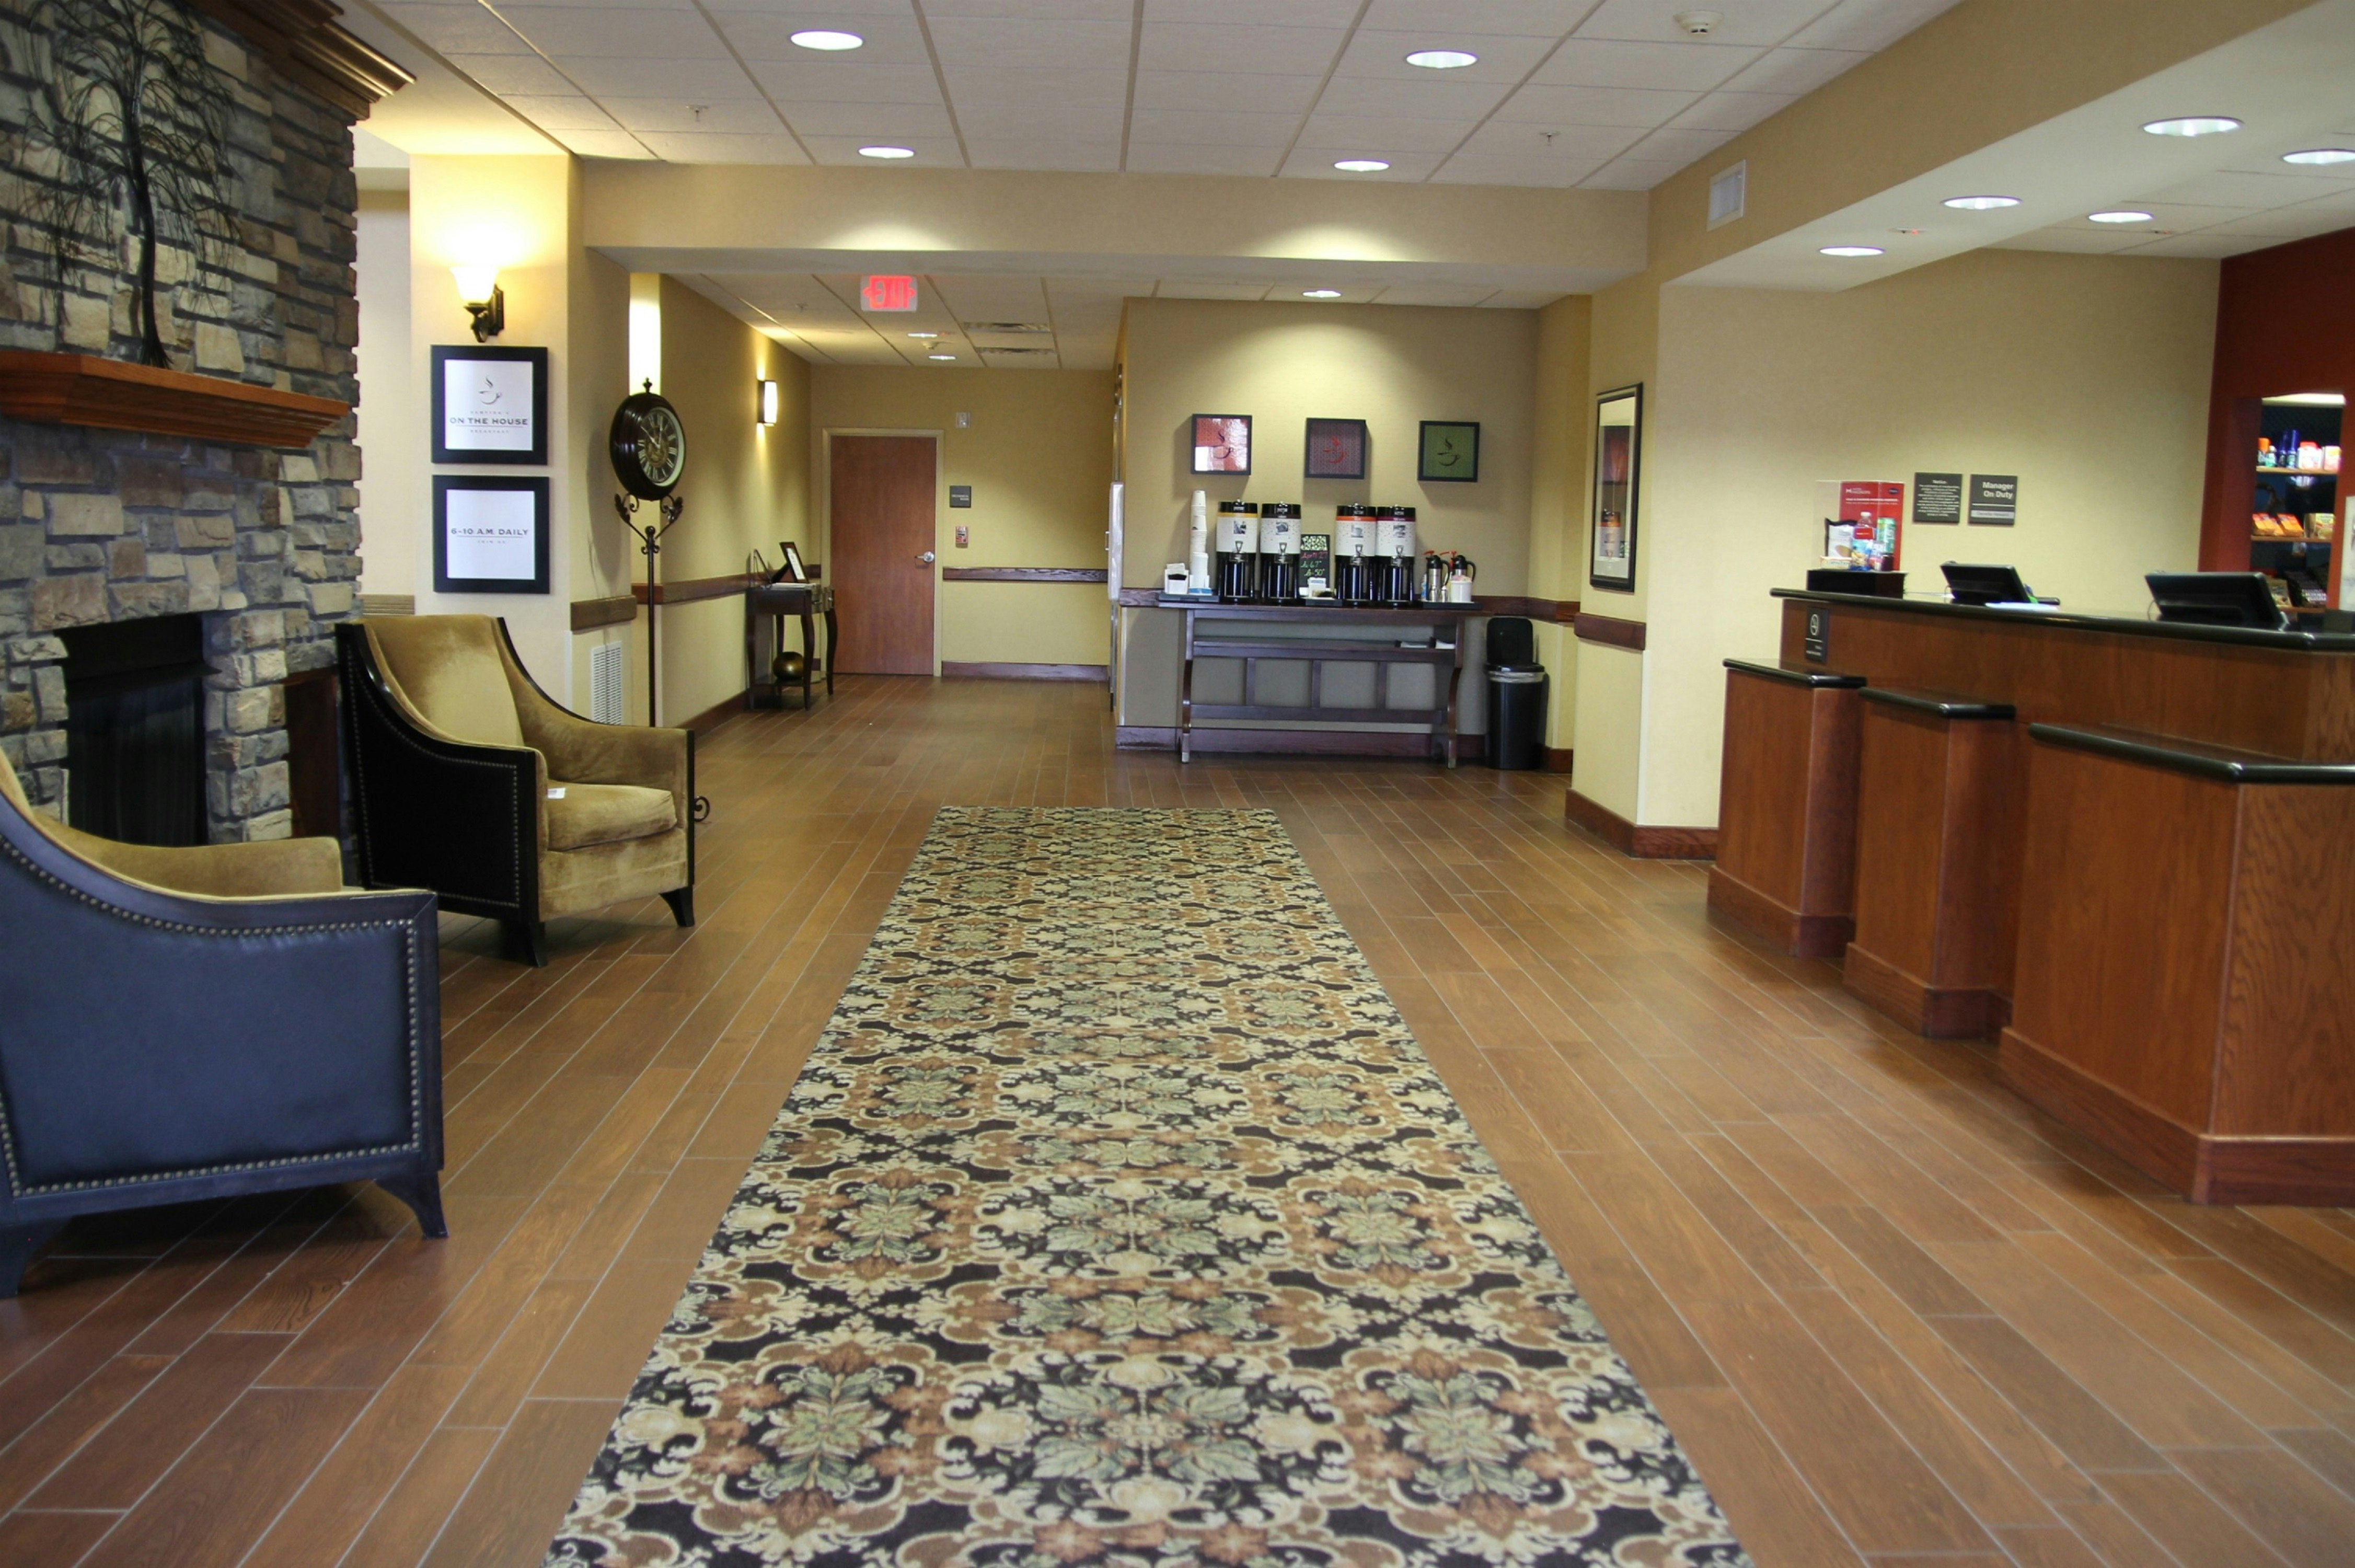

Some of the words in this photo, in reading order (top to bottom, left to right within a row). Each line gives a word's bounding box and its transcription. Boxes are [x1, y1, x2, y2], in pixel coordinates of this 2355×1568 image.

[869, 275, 912, 309] EXIT
[1982, 481, 2014, 490] Manager
[1996, 491, 2013, 500] Duty
